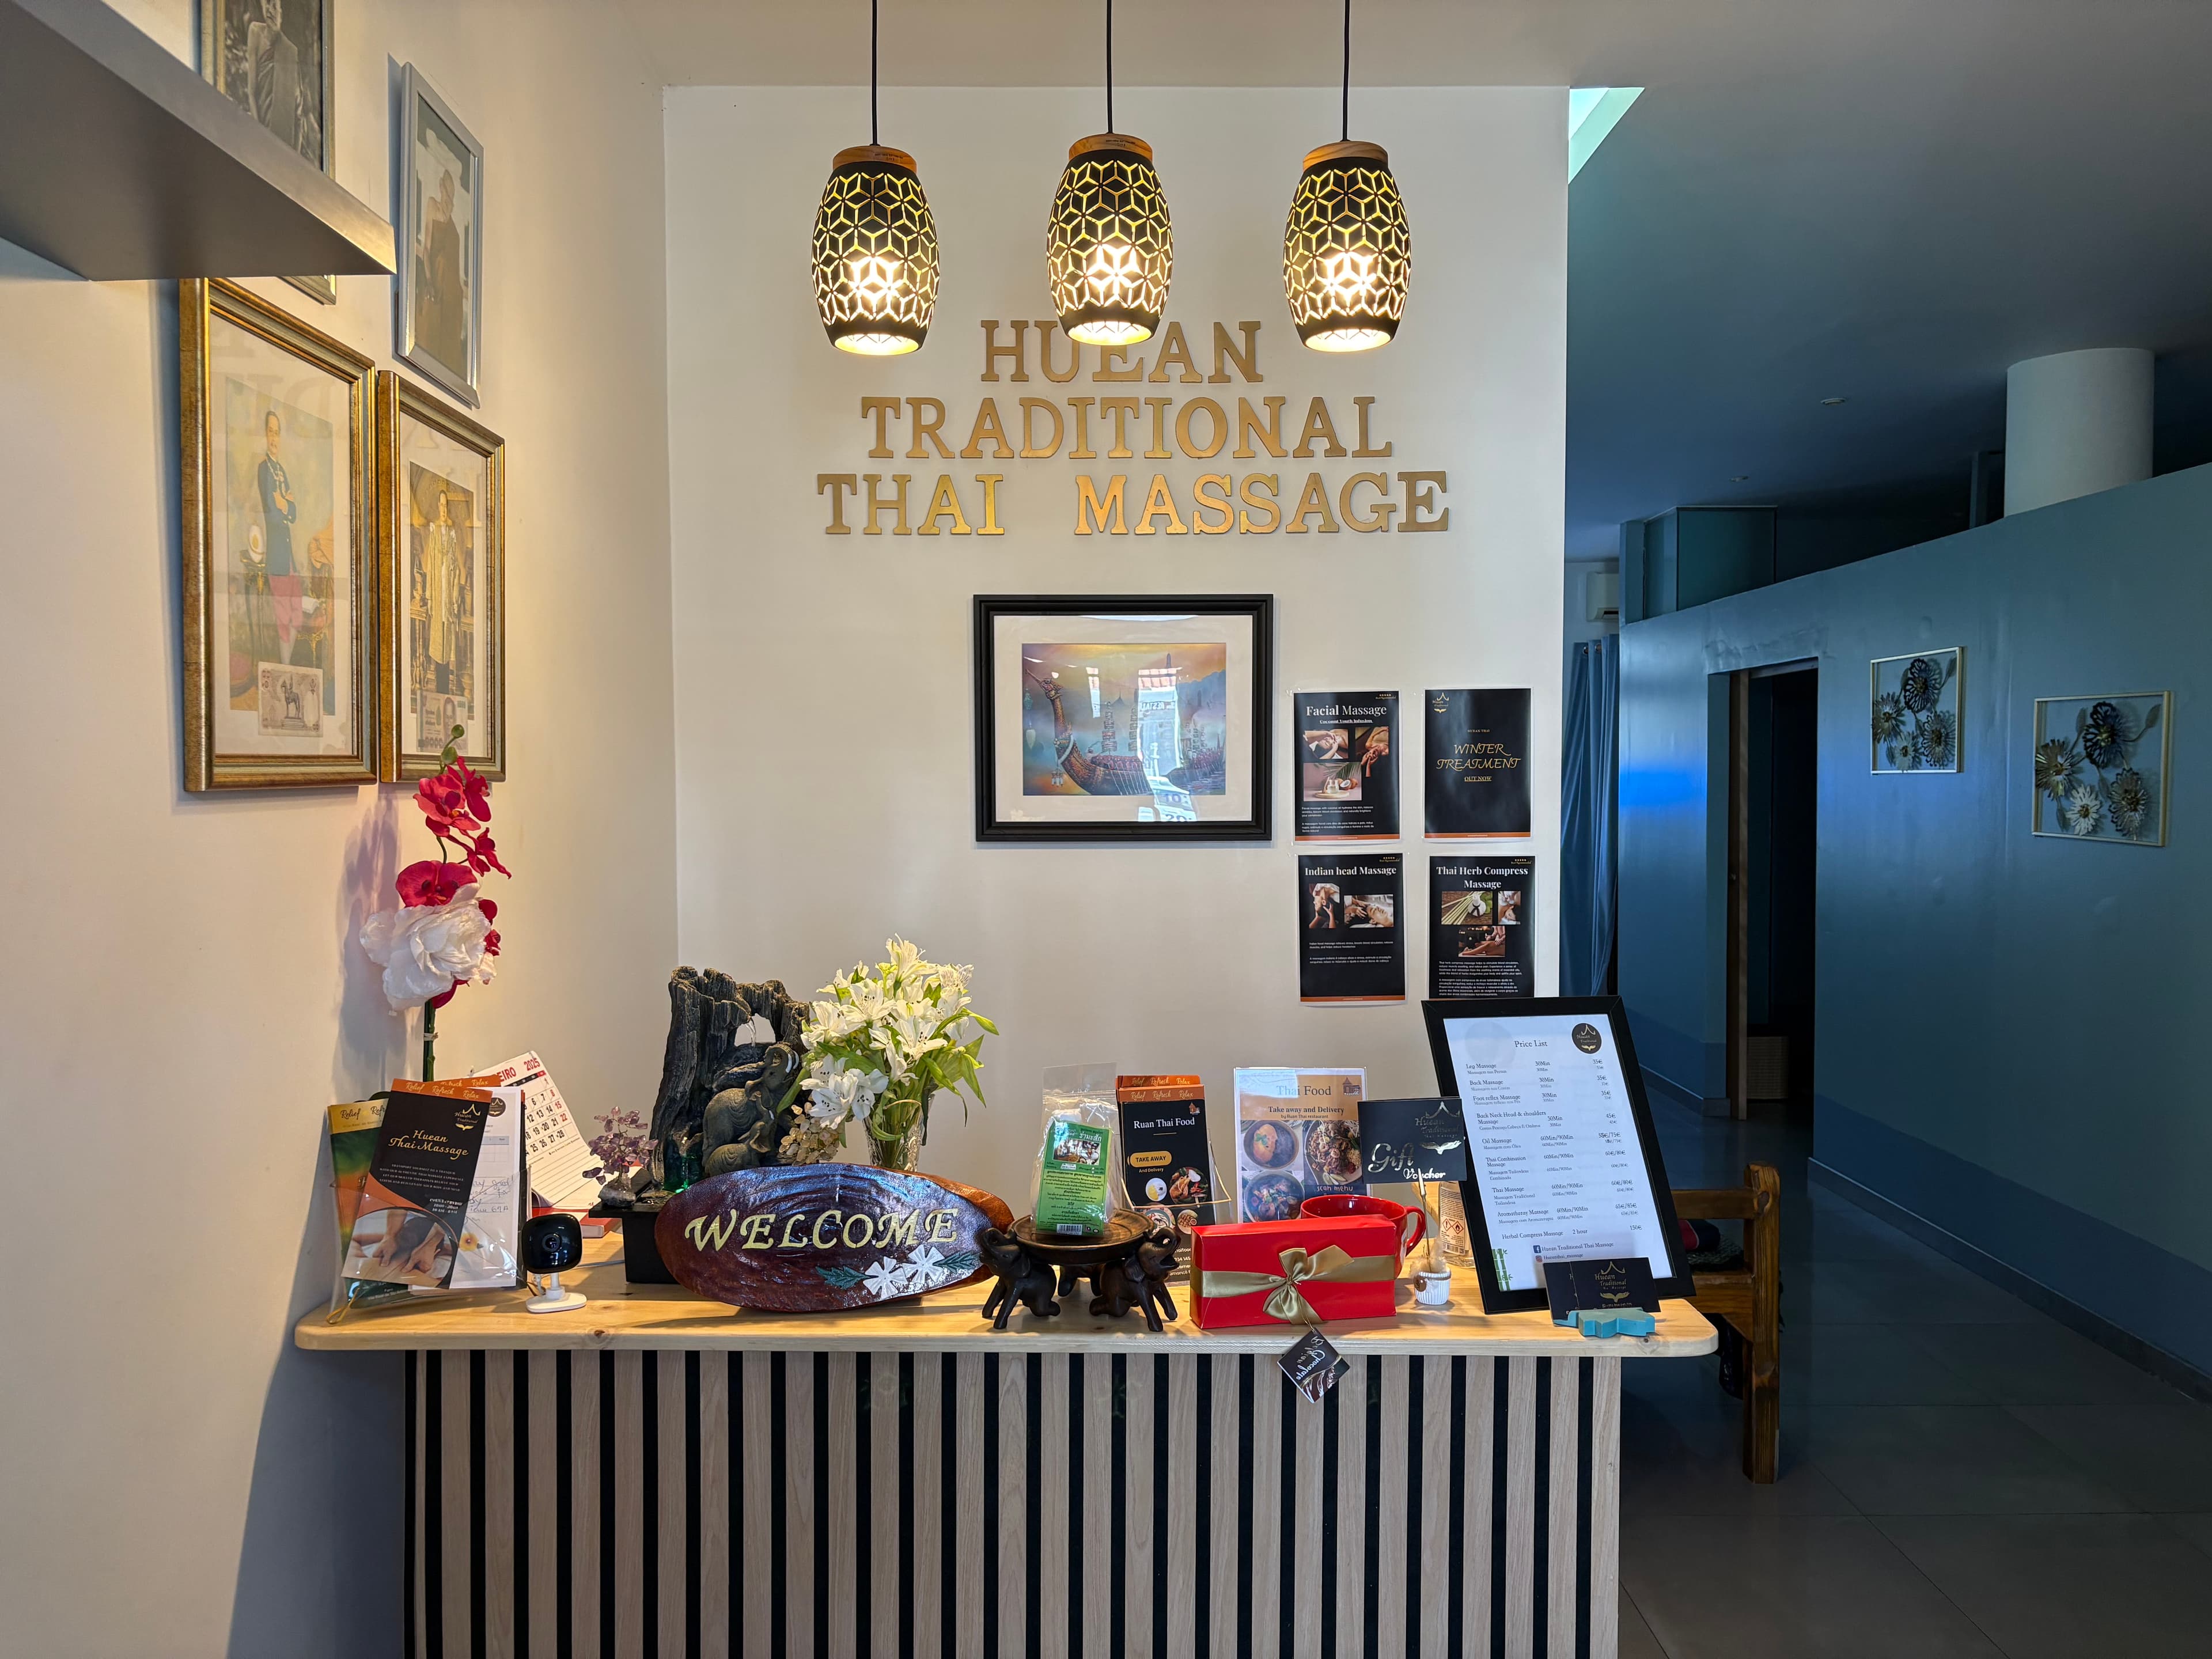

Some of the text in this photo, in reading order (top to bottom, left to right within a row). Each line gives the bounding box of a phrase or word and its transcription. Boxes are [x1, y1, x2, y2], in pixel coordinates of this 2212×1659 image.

[980, 320, 1263, 382] HUEAN
[861, 396, 1392, 459] TRADITIONAL
[817, 470, 1449, 536] THAI MASSAGE
[1306, 705, 1387, 717] Facial Massage
[1454, 743, 1512, 756] WINTER
[1436, 757, 1521, 771] TREATMENT
[1305, 866, 1396, 876] Indian head Massage
[1437, 866, 1528, 876] Thai Herb Compress
[1464, 880, 1502, 889] Massage
[524, 1058, 541, 1071] 2025
[472, 1079, 488, 1087] Relax
[1150, 1077, 1169, 1086] Refresh
[1176, 1077, 1191, 1085] Relax
[406, 1082, 425, 1093] Relief
[432, 1085, 454, 1096] Refresh
[463, 1089, 480, 1099] Relax
[1131, 1090, 1194, 1101] Relief Refresh Relax
[1277, 1085, 1331, 1096] Thai Food
[531, 1098, 536, 1106] 6
[340, 1108, 361, 1120] Relief
[527, 1101, 562, 1123] 12 13 14 15
[1317, 1106, 1344, 1116] Delivery
[533, 1127, 540, 1135] 19
[542, 1122, 550, 1131] 20
[551, 1119, 559, 1127] 21
[560, 1113, 568, 1123] 22
[1134, 1118, 1195, 1129] Ruan Thai Food
[412, 1130, 448, 1143] Huean
[530, 1130, 565, 1153] 25 26 27 28
[388, 1135, 469, 1161] Thai Massage
[1368, 1143, 1414, 1173] Gift
[685, 1207, 959, 1252] WELCOME
